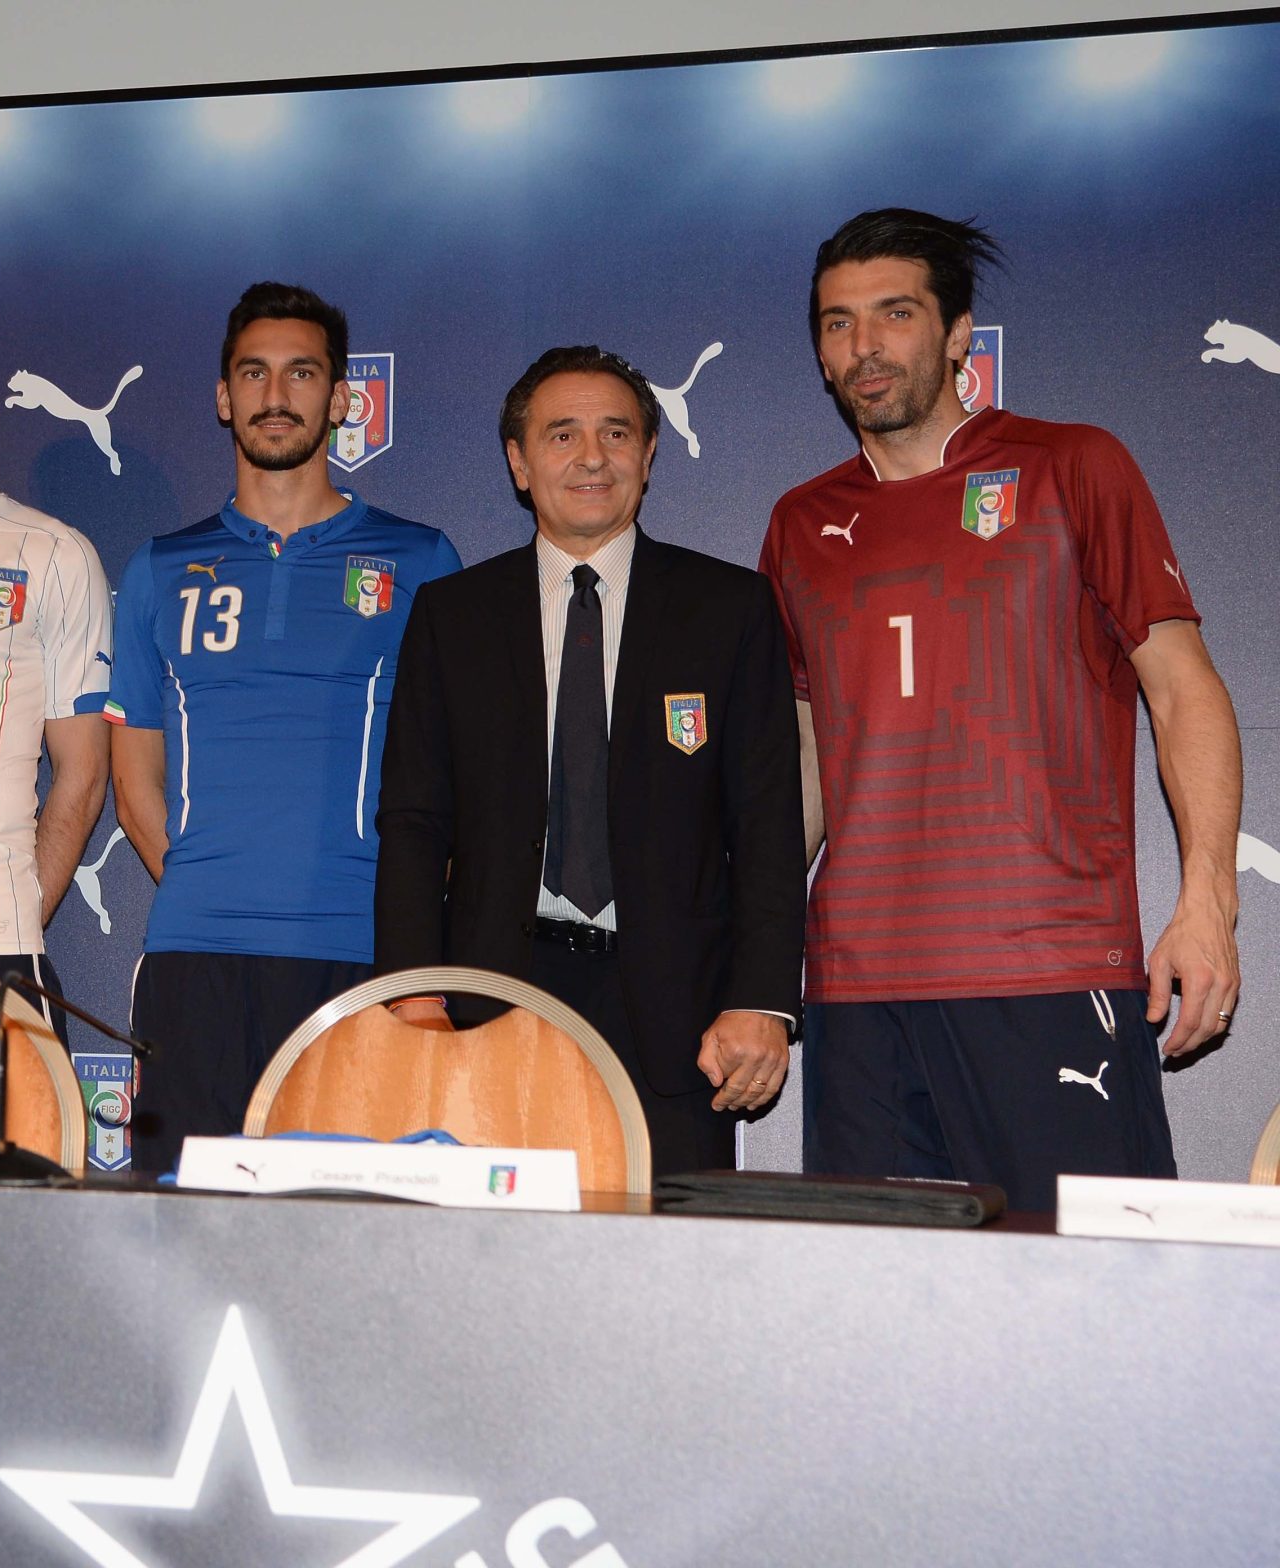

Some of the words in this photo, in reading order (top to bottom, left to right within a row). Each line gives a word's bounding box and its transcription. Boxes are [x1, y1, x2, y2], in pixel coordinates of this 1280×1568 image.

[345, 365, 380, 377] LIA
[972, 474, 1012, 486] ITALIA
[353, 559, 388, 572] ITALIA
[179, 585, 243, 656] 13
[888, 614, 915, 698] 1
[101, 1105, 121, 1114] FIGC
